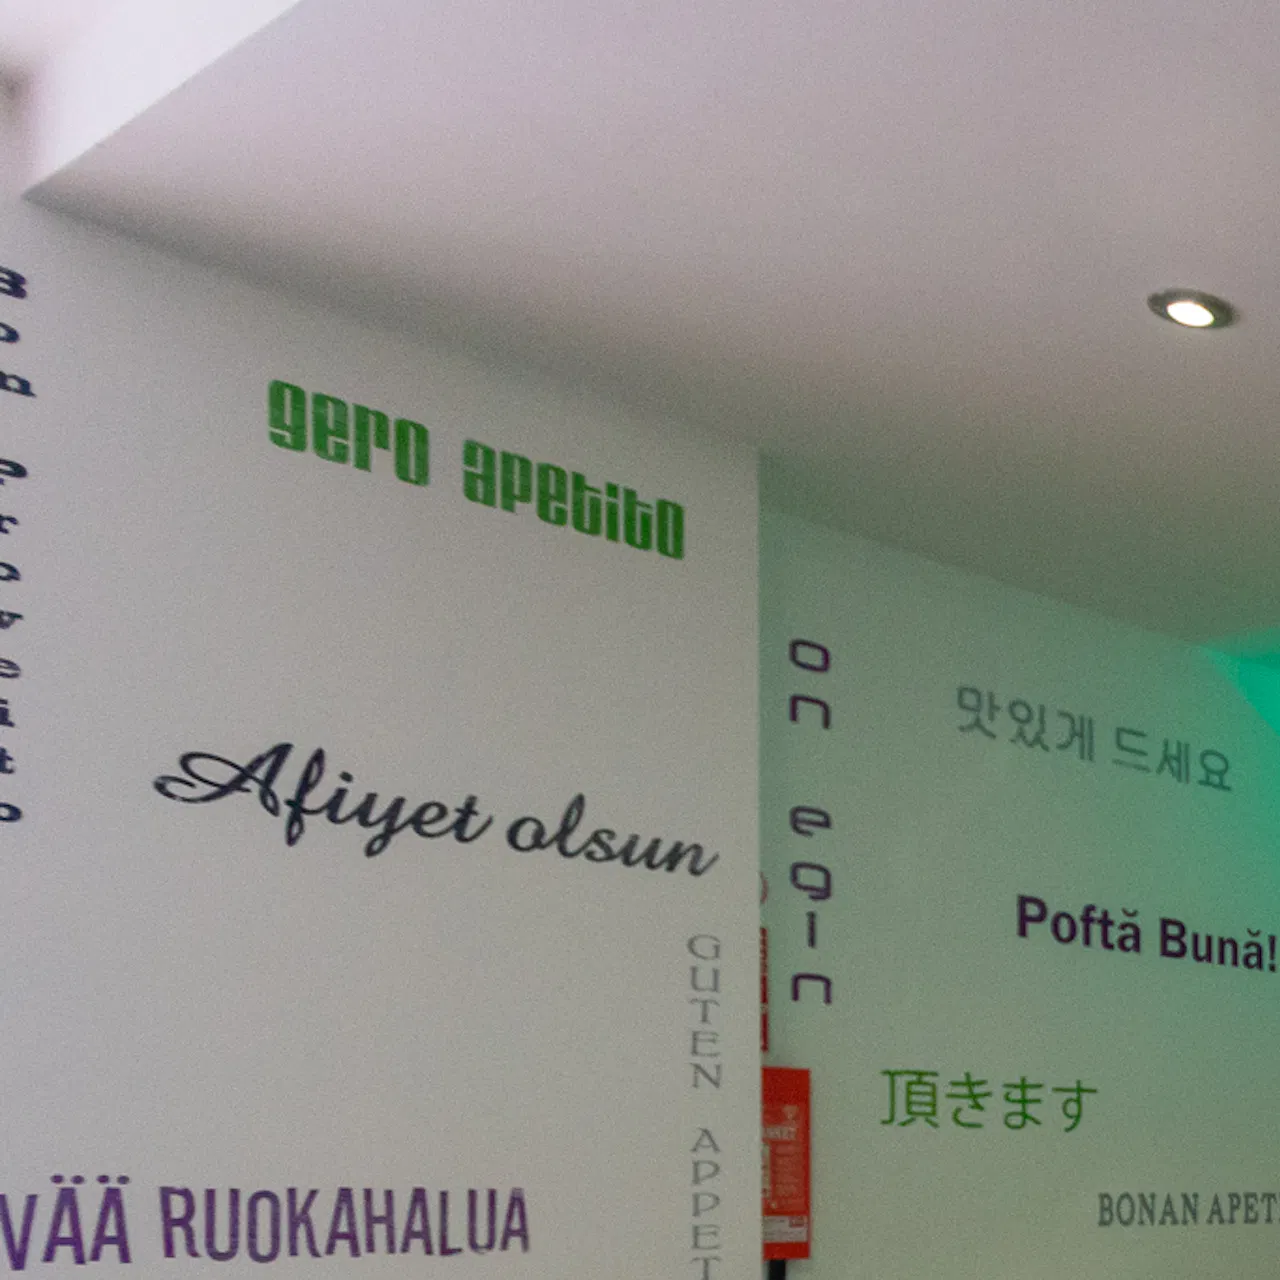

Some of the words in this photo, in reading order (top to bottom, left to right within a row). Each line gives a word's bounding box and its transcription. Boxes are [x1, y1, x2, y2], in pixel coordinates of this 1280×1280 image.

[269, 380, 429, 486] gero
[463, 439, 685, 559] apetito
[789, 639, 831, 729] on
[956, 686, 1096, 762] 맛있게
[1112, 726, 1232, 791] 드세요
[153, 743, 494, 858] Afiyet
[506, 793, 719, 877] olsun
[789, 806, 832, 1004] egin
[1016, 895, 1142, 954] Poftă
[1159, 917, 1278, 973] Bună!
[686, 934, 722, 1090] GUTEN
[880, 1069, 1098, 1133] 頂きます
[0, 1174, 132, 1271] VÄÄ
[160, 1185, 531, 1264] RUOKAHALUA
[1098, 1191, 1199, 1227] BONAN
